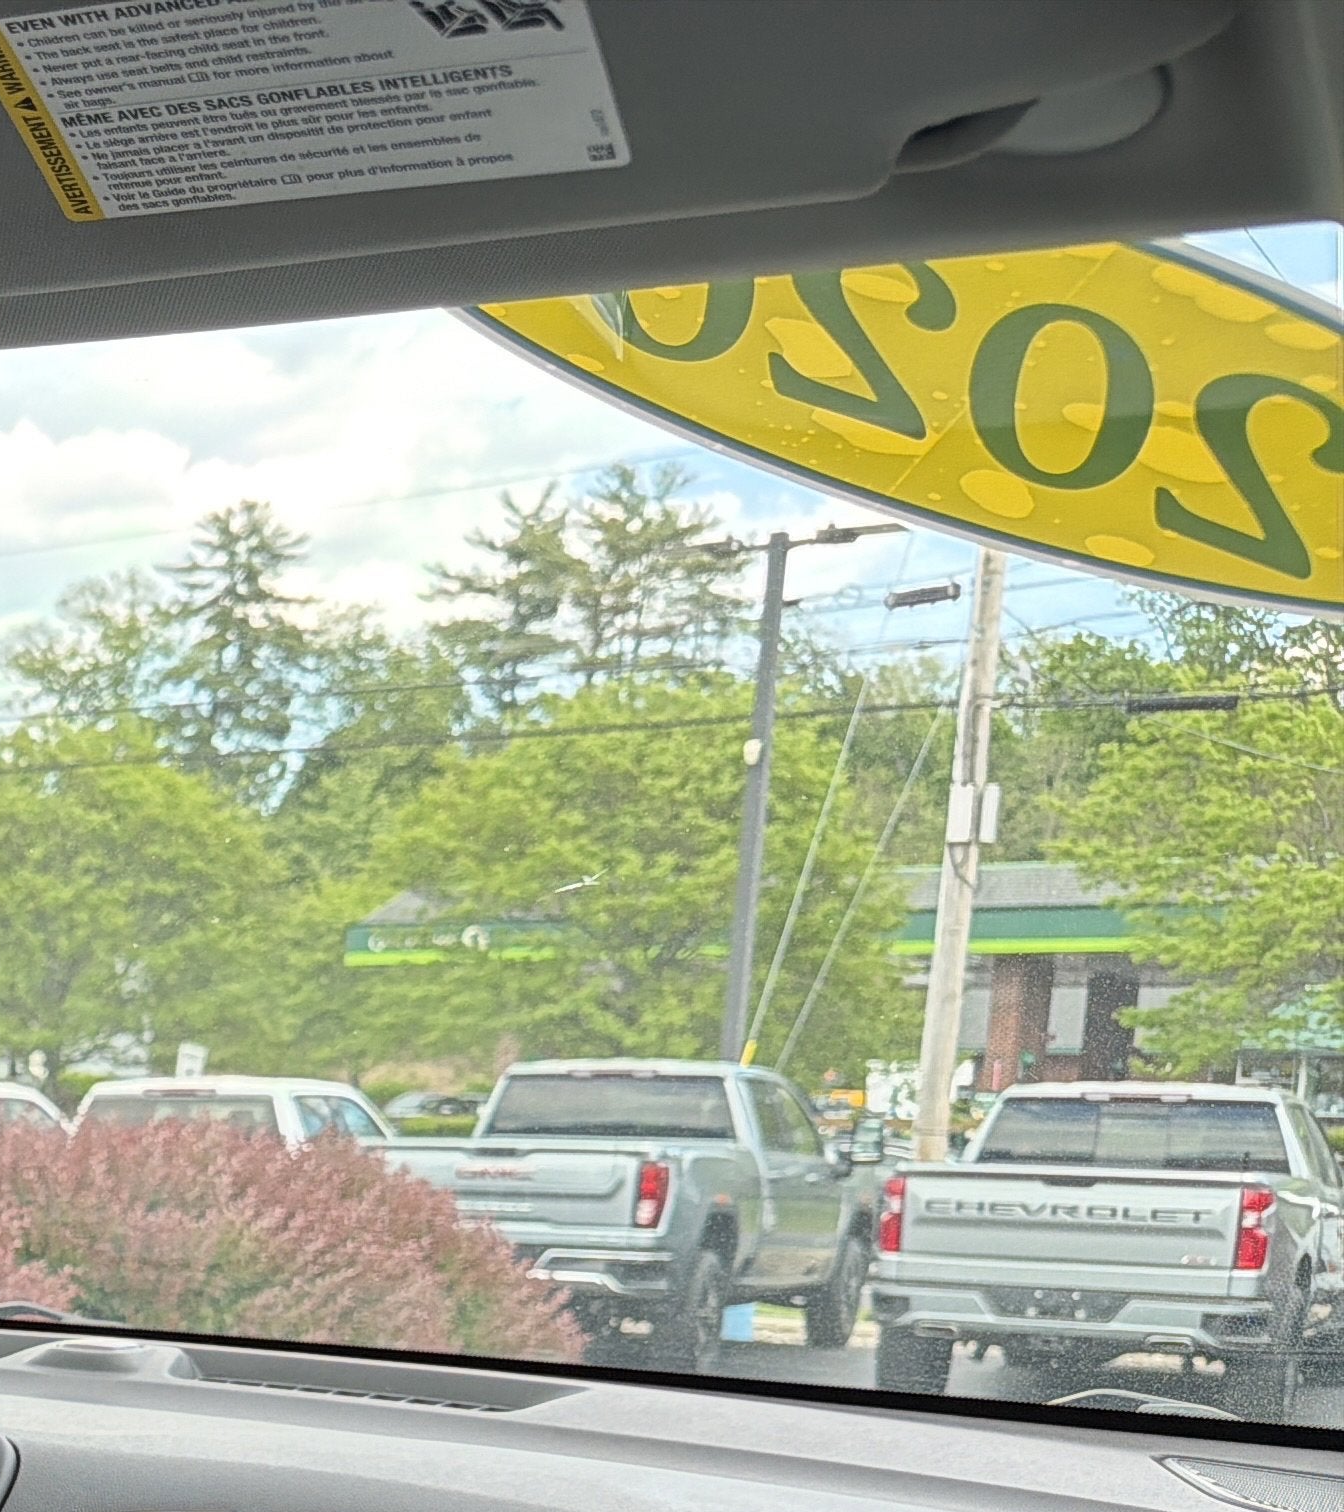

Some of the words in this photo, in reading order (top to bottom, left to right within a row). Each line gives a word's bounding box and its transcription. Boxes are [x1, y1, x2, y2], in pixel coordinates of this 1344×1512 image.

[4, 17, 57, 35] EVEN
[57, 9, 110, 27] WITH
[26, 33, 81, 48] Children
[82, 30, 108, 40] can
[126, 21, 165, 34] killed
[183, 10, 244, 26] seriously
[246, 3, 296, 19] injured
[34, 51, 60, 60] The
[59, 45, 93, 57] back
[93, 41, 122, 53] seat
[160, 30, 202, 44] safest
[202, 27, 239, 40] place
[240, 24, 260, 33] for
[41, 62, 78, 73] Never
[80, 58, 104, 70] put
[115, 48, 187, 64] rear-facing
[187, 42, 220, 55] child
[221, 38, 252, 50] seat
[50, 74, 95, 87] Always
[95, 71, 120, 81] use
[120, 66, 150, 78] seat
[149, 62, 183, 74] belts
[184, 57, 210, 69] and
[211, 53, 244, 66] child
[56, 89, 83, 99] See
[84, 81, 137, 96] owner's
[137, 74, 187, 89] manual
[212, 70, 232, 80] for
[234, 66, 270, 77] more
[271, 56, 351, 73] information
[353, 49, 394, 63] about
[60, 111, 114, 129] MÊME
[117, 105, 163, 122] AVEC
[164, 101, 202, 116] DES
[203, 95, 254, 111] SACS
[256, 80, 376, 105] GONFLABLES
[378, 64, 513, 91] INTELLIGENTS
[63, 100, 80, 110] air
[78, 129, 102, 139] Les
[103, 123, 149, 136] enfants
[150, 116, 201, 132] peuvent
[279, 99, 349, 117] gravement
[403, 90, 427, 103] par
[180, 128, 202, 139] est
[270, 118, 300, 131] plus
[324, 111, 354, 124] pour
[356, 109, 378, 119] les
[109, 147, 152, 161] jamais
[152, 143, 190, 156] placer
[202, 135, 247, 148] l'avant
[266, 126, 325, 141] dispositif
[346, 118, 413, 134] protection
[414, 114, 446, 127] pour
[448, 108, 492, 122] enfant
[22, 115, 93, 214] AVERTISSEMENT
[96, 158, 139, 170] faisant
[138, 156, 166, 166] face
[101, 169, 155, 182] Toujours
[155, 164, 196, 176] utiliser
[198, 162, 218, 171] les
[219, 155, 278, 169] ceintures
[366, 143, 389, 153] les
[390, 136, 462, 151] ensembles
[107, 179, 153, 191] retenue
[154, 176, 182, 188] pour
[111, 192, 136, 202] Voir
[151, 187, 187, 198] Guide
[206, 177, 278, 194] propriétaire
[305, 171, 334, 183] pour
[337, 168, 366, 180] plus
[367, 159, 453, 176] d'information
[467, 153, 514, 167] propos
[117, 203, 141, 212] des
[140, 199, 170, 210] sacs
[924, 1198, 1213, 1224] CHEVROLET
